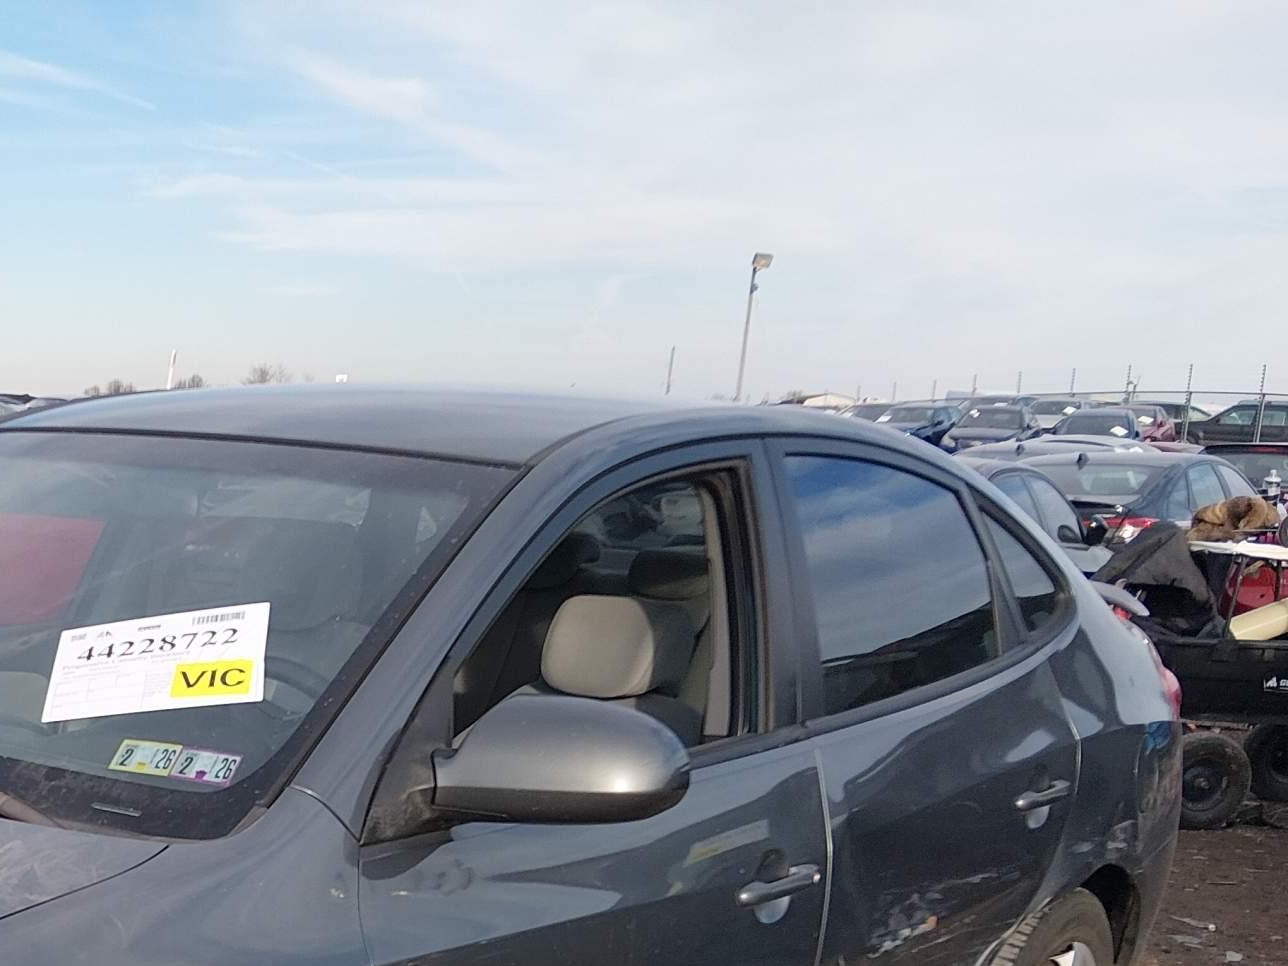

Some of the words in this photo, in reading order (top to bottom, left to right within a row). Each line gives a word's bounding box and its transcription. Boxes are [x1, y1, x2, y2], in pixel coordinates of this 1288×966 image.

[77, 628, 239, 661] 44228722
[180, 668, 246, 688] VIC
[119, 748, 135, 767] 2
[154, 748, 177, 770] 26
[178, 756, 194, 775] 2
[214, 757, 237, 780] 26
